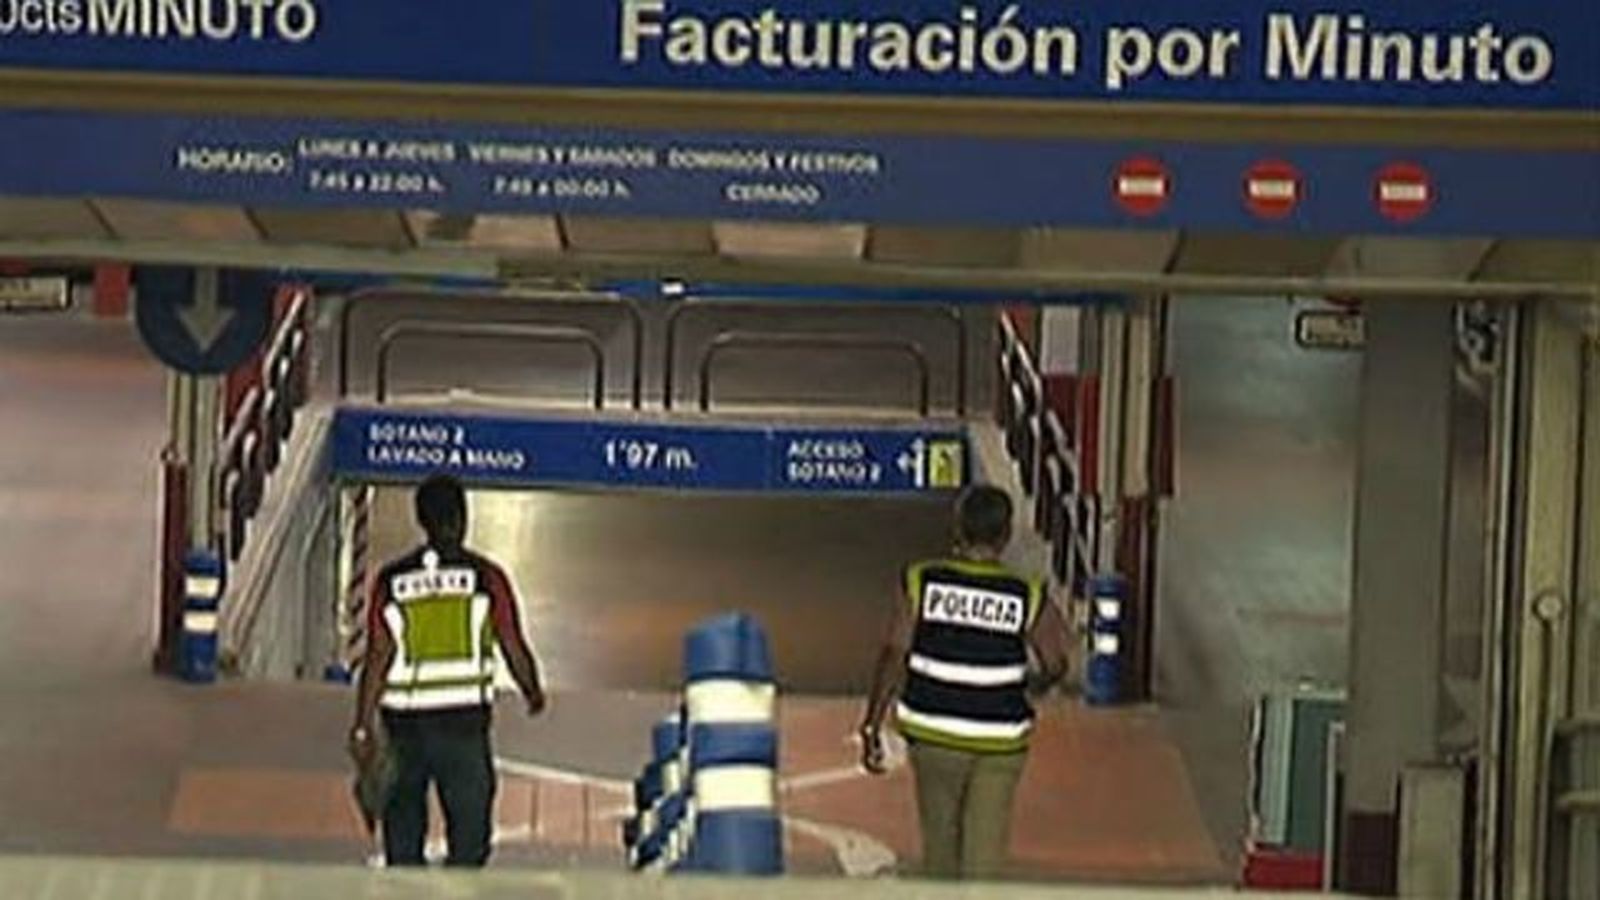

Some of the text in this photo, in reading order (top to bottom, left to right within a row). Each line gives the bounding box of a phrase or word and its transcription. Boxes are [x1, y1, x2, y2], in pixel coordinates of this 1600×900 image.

[619, 0, 1553, 90] Facturación por Minuto
[927, 588, 1019, 625] POLICIA
